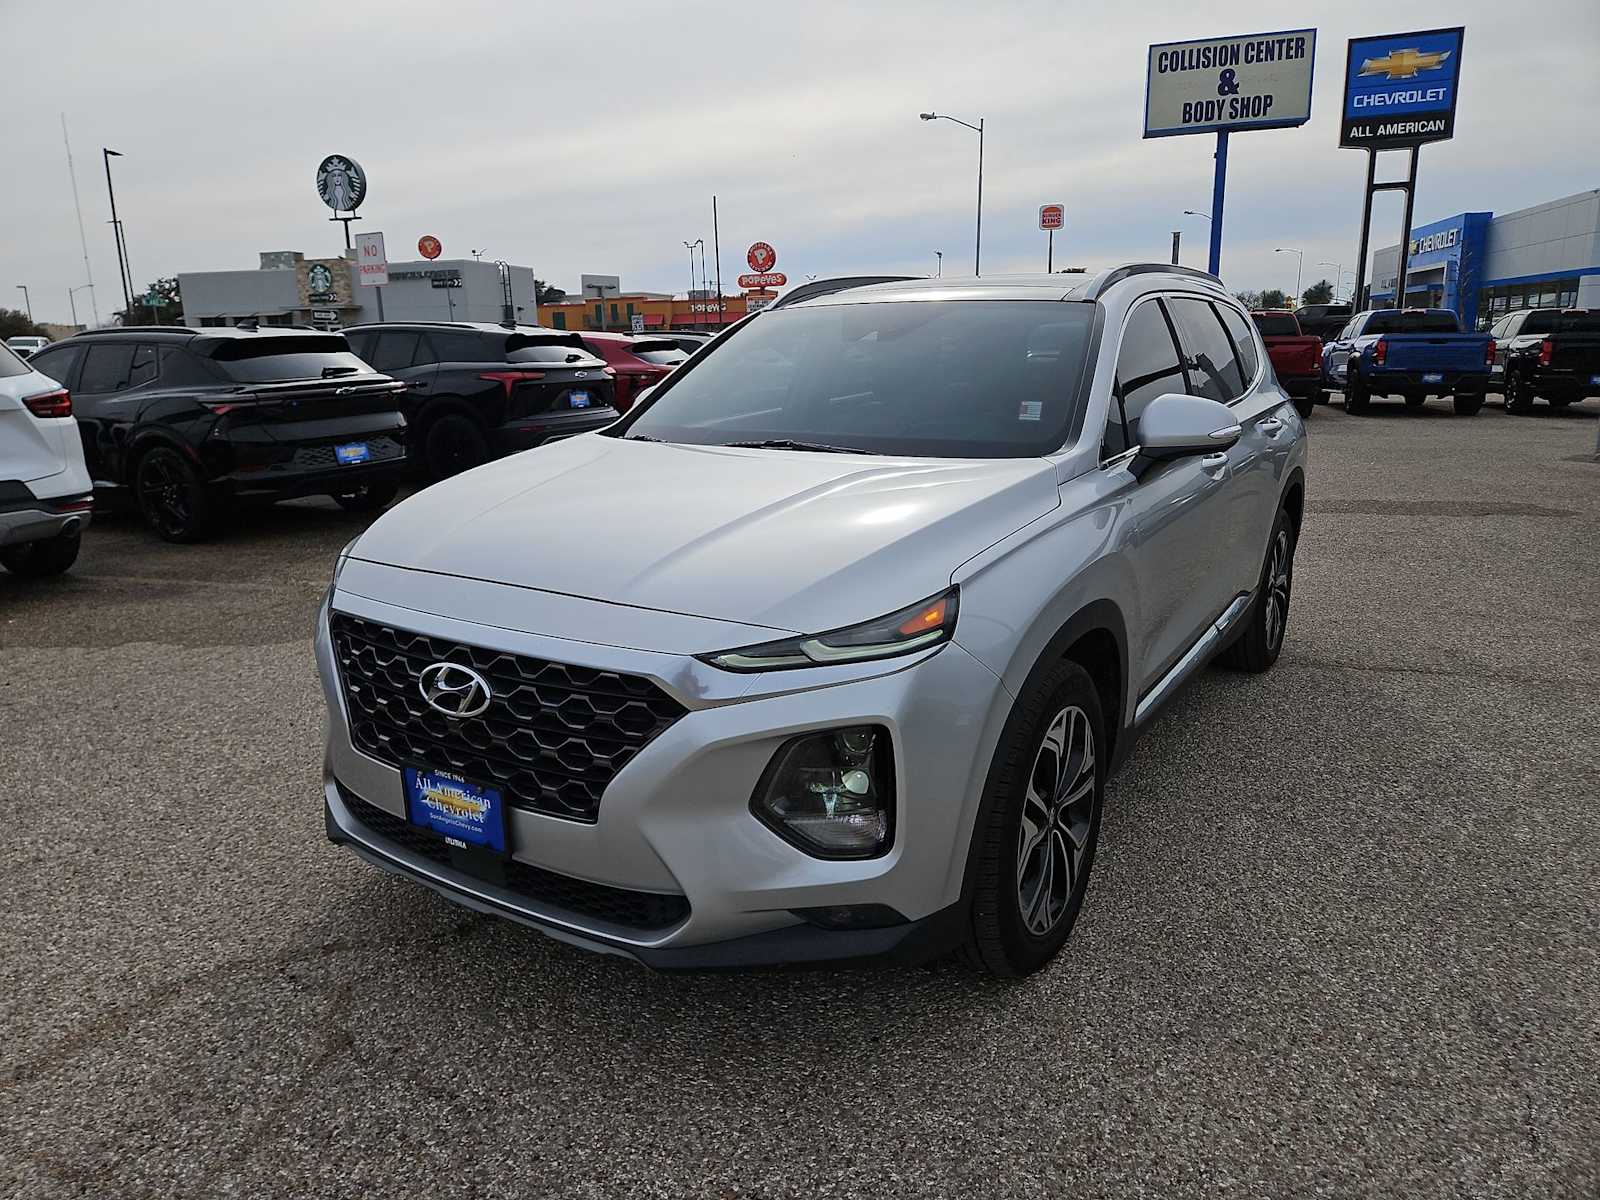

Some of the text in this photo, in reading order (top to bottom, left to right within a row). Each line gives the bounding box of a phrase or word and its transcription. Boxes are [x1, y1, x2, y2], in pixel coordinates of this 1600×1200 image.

[1158, 37, 1305, 73] COLLISION CENTER
[1217, 68, 1240, 96] &
[1182, 94, 1273, 124] BODY SHOP
[1353, 88, 1447, 108] CHEVROLET
[1349, 119, 1446, 138] ALL AMERICAN
[1042, 217, 1061, 225] KING
[363, 244, 378, 257] NO
[1419, 228, 1458, 254] CHEVROLET
[359, 263, 385, 274] PARKING
[434, 769, 451, 780] SINCE
[415, 777, 491, 809] All American
[426, 796, 484, 823] Chevrolet
